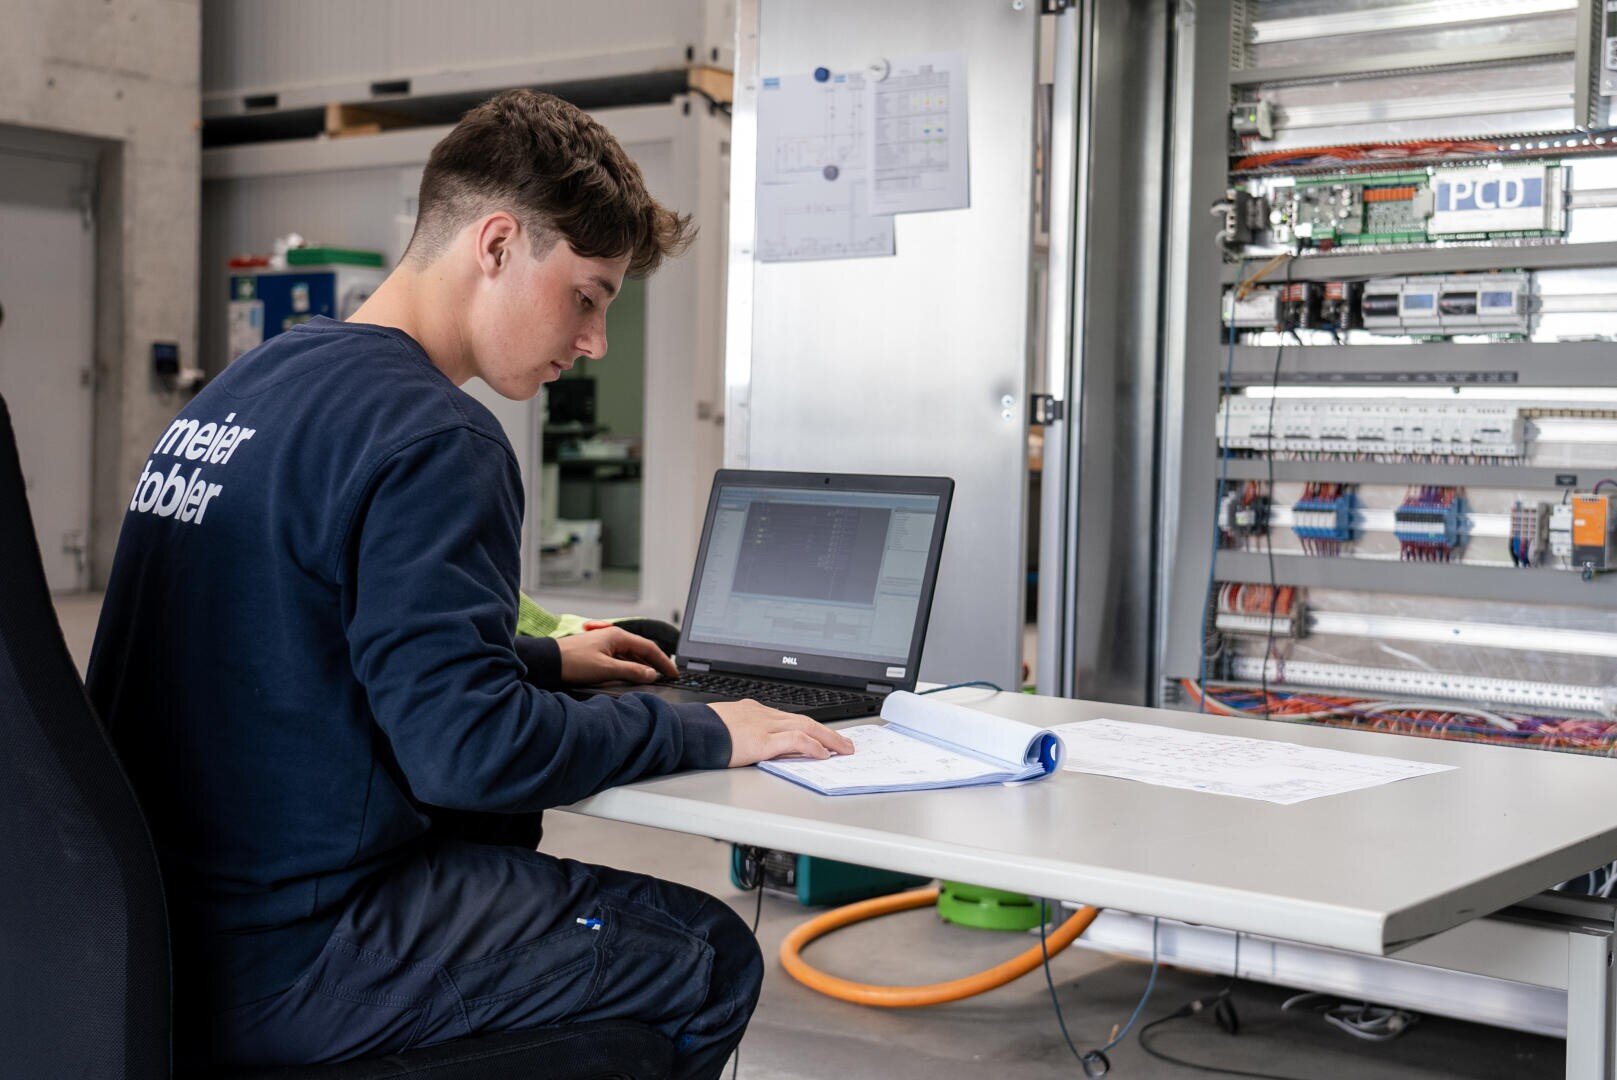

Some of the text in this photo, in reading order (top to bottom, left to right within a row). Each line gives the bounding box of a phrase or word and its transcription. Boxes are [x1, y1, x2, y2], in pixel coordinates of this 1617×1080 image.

[1448, 178, 1524, 211] PCD
[153, 412, 257, 465] meier
[129, 459, 224, 525] tobler
[782, 656, 798, 665] DELL
